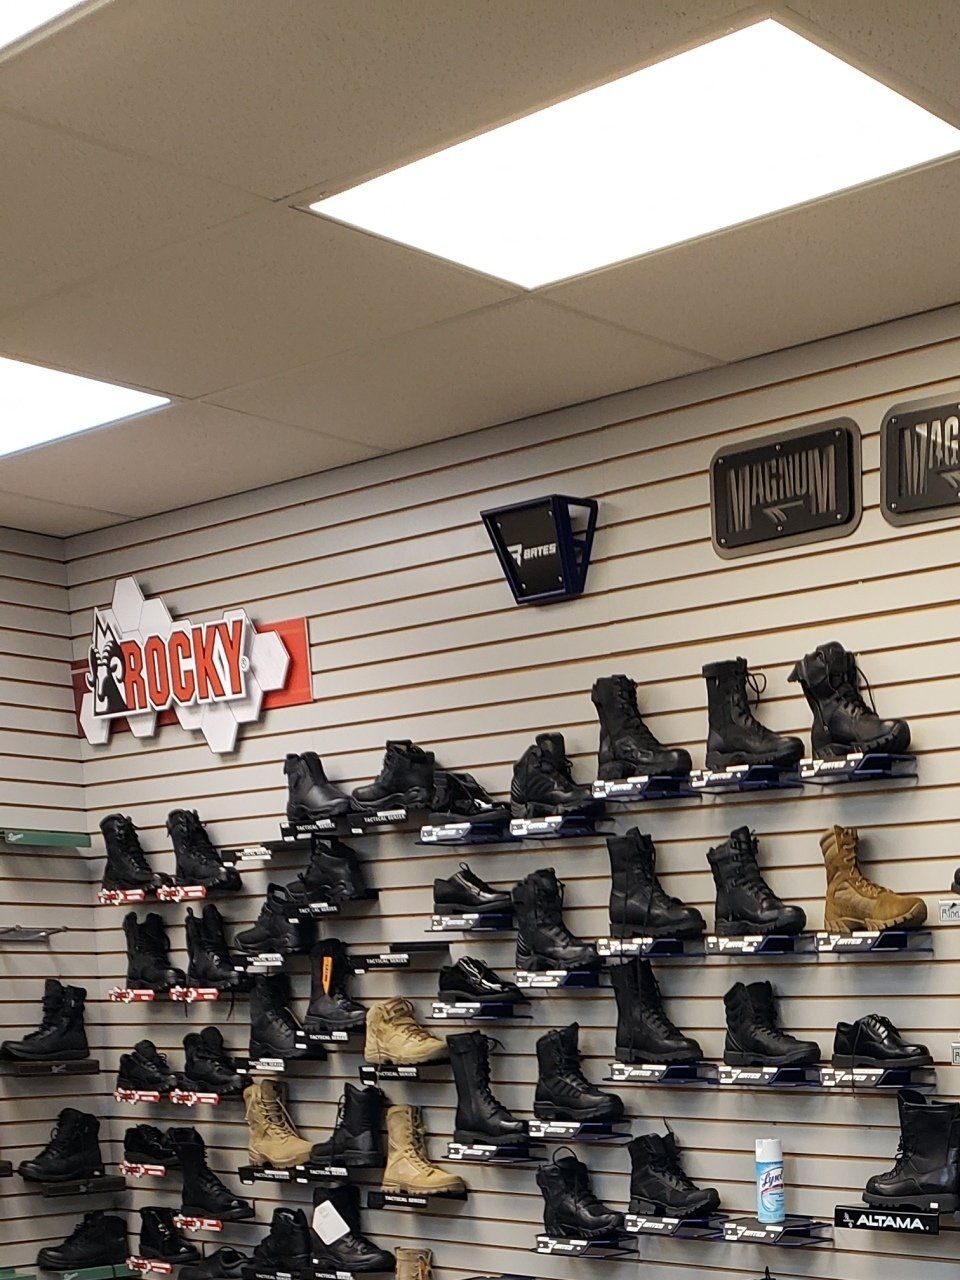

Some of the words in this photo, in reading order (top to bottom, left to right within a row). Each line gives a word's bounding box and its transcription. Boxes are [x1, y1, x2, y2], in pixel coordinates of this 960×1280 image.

[727, 445, 836, 533] MAGNUM
[120, 620, 243, 710] ROCKY
[856, 1213, 925, 1231] ALTAMA
